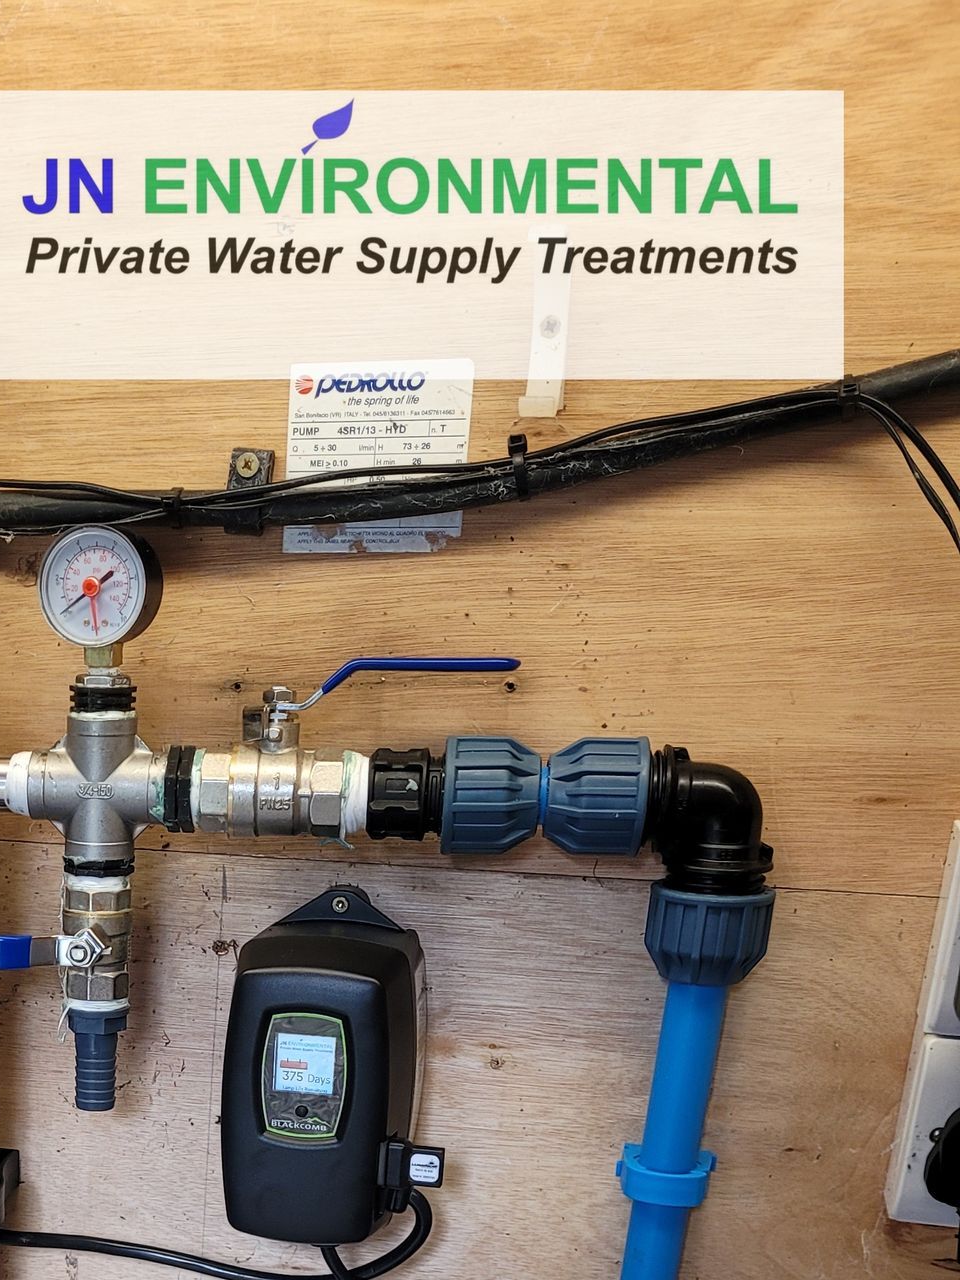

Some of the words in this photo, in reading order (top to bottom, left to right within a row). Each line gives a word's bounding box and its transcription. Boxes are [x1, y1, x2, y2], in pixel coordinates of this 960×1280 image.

[347, 396, 362, 405] the
[364, 396, 393, 407] spring
[394, 396, 405, 404] of
[406, 395, 420, 404] life
[292, 427, 320, 436] PUMP
[337, 425, 376, 435] 4SR1/13
[385, 424, 407, 434] HYD
[440, 424, 447, 433] T
[403, 442, 412, 450] 73
[421, 442, 431, 450] 26
[332, 459, 348, 467] 0.10
[412, 457, 422, 465] 26
[273, 772, 281, 790] 1
[282, 1070, 304, 1082] 375
[307, 1074, 331, 1085] Days
[271, 1118, 328, 1132] BLACKCOMB
